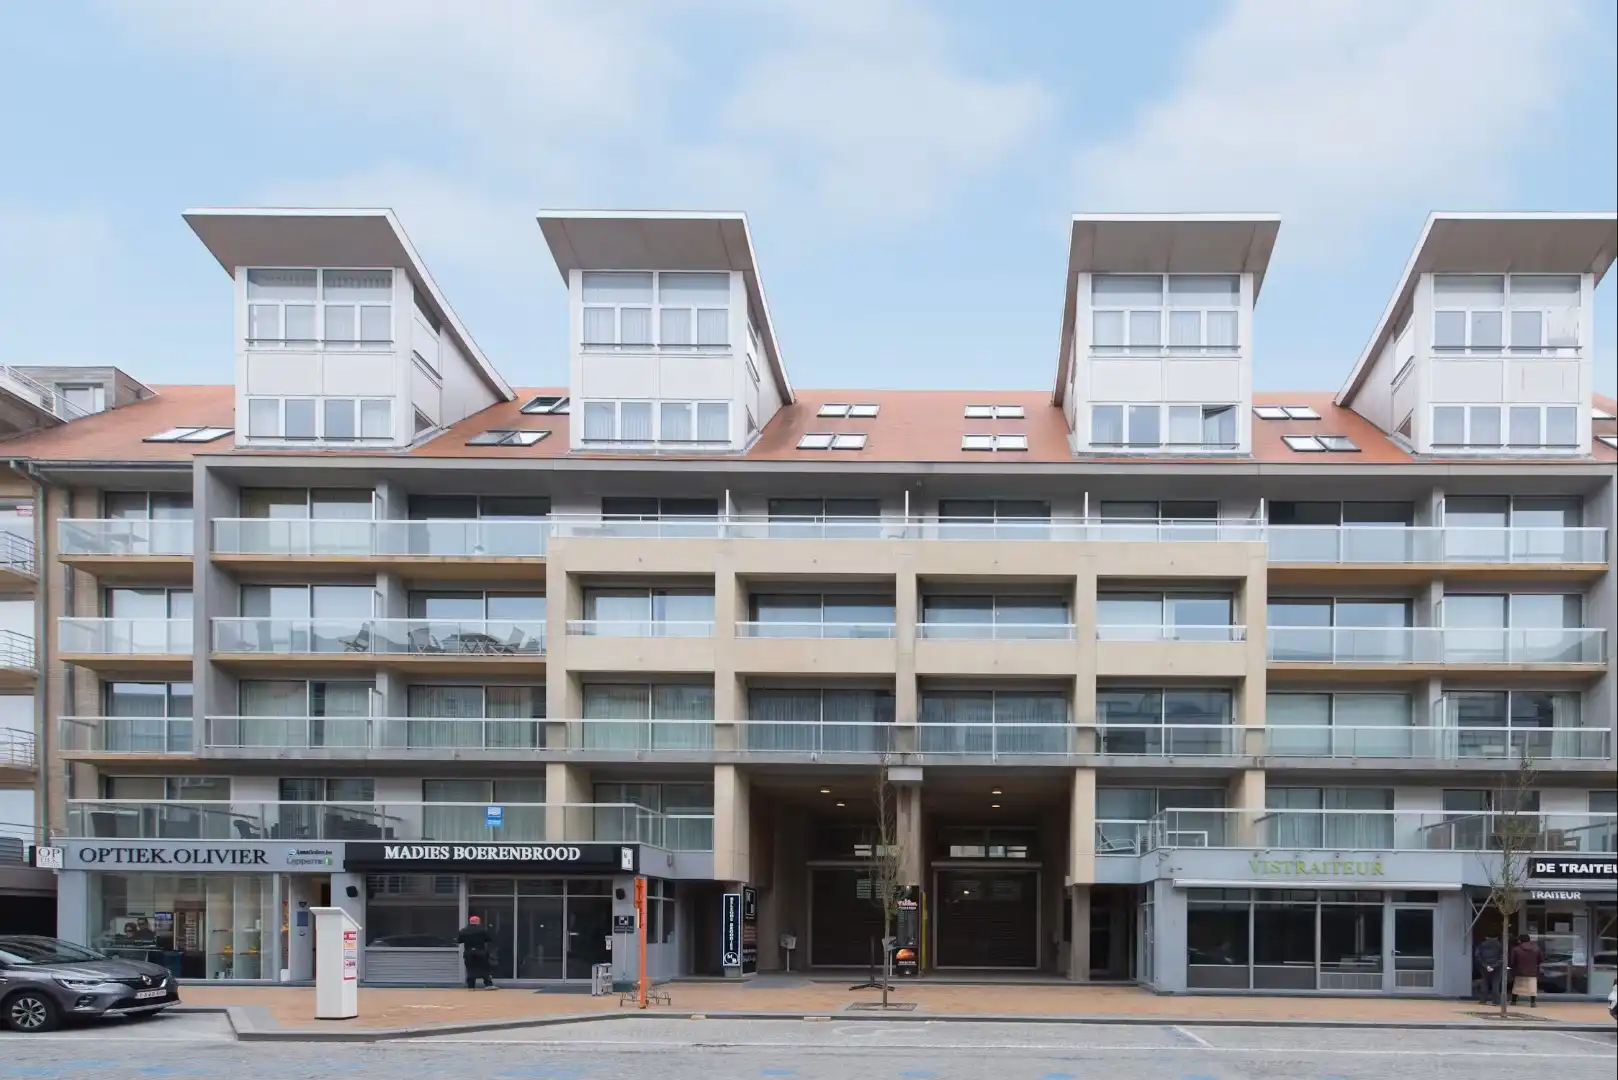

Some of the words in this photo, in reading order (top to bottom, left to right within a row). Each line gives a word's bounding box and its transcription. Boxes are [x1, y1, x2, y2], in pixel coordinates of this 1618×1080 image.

[38, 847, 60, 858] OP
[384, 846, 450, 860] MADIES
[452, 846, 581, 861] BOERENBROOD
[1248, 859, 1385, 875] VISTRAITEUR
[1536, 863, 1556, 873] DE
[1530, 890, 1581, 899] TRAITEUR
